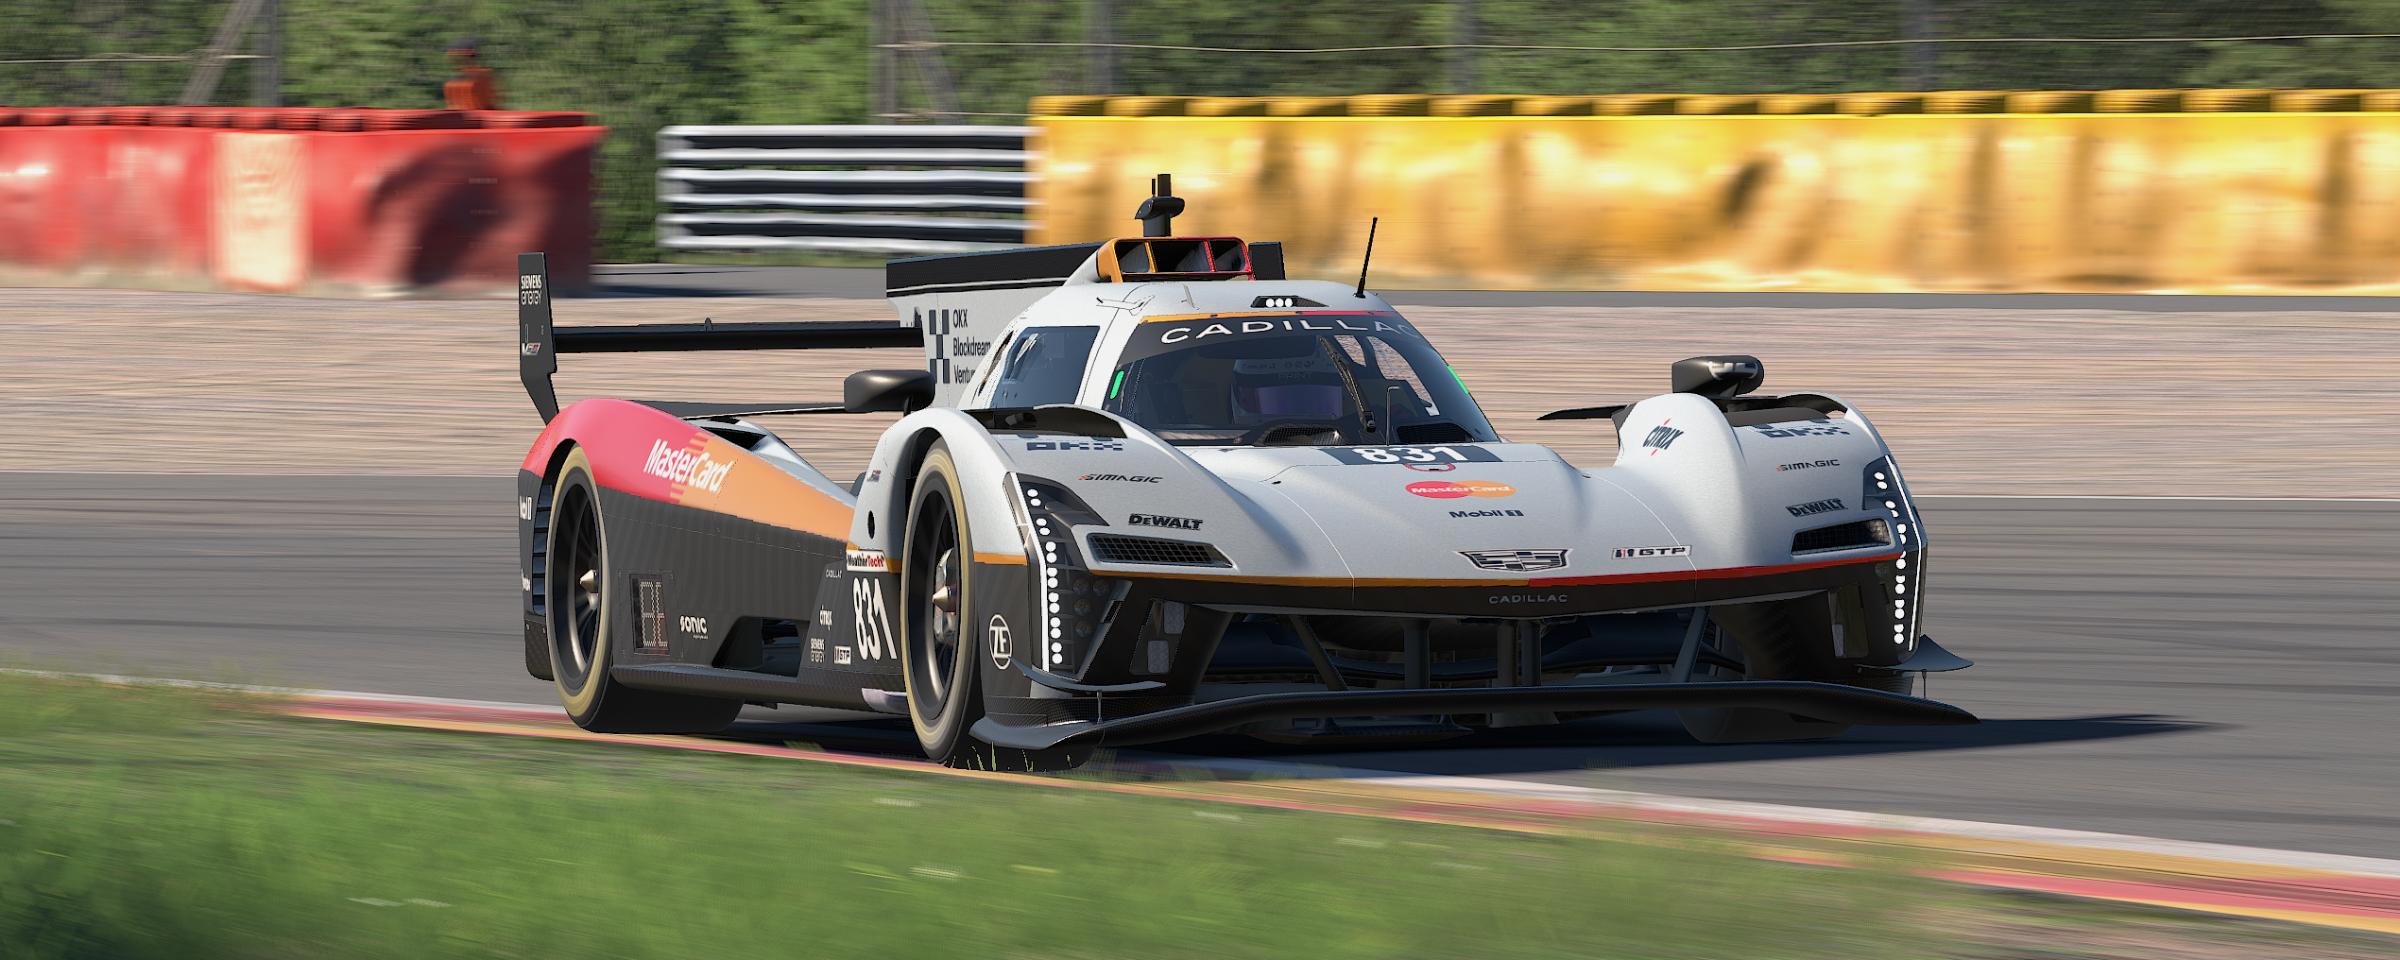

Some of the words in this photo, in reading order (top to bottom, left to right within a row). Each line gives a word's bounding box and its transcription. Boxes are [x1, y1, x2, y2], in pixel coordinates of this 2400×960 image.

[521, 275, 541, 289] SIEMENS
[953, 309, 968, 328] OKX
[1160, 318, 1417, 345] CADILLAC
[1027, 442, 1123, 450] OKX
[1352, 447, 1469, 463] 831
[643, 438, 734, 493] MasterCard
[1776, 459, 1840, 472] SIMAGIC
[1078, 473, 1164, 483] SIMAGIC
[1449, 509, 1503, 518] Mobil
[1639, 547, 1687, 555] GTP
[1489, 594, 1568, 604] CADILLAC
[853, 578, 897, 660] 831
[991, 627, 1011, 658] ZF
